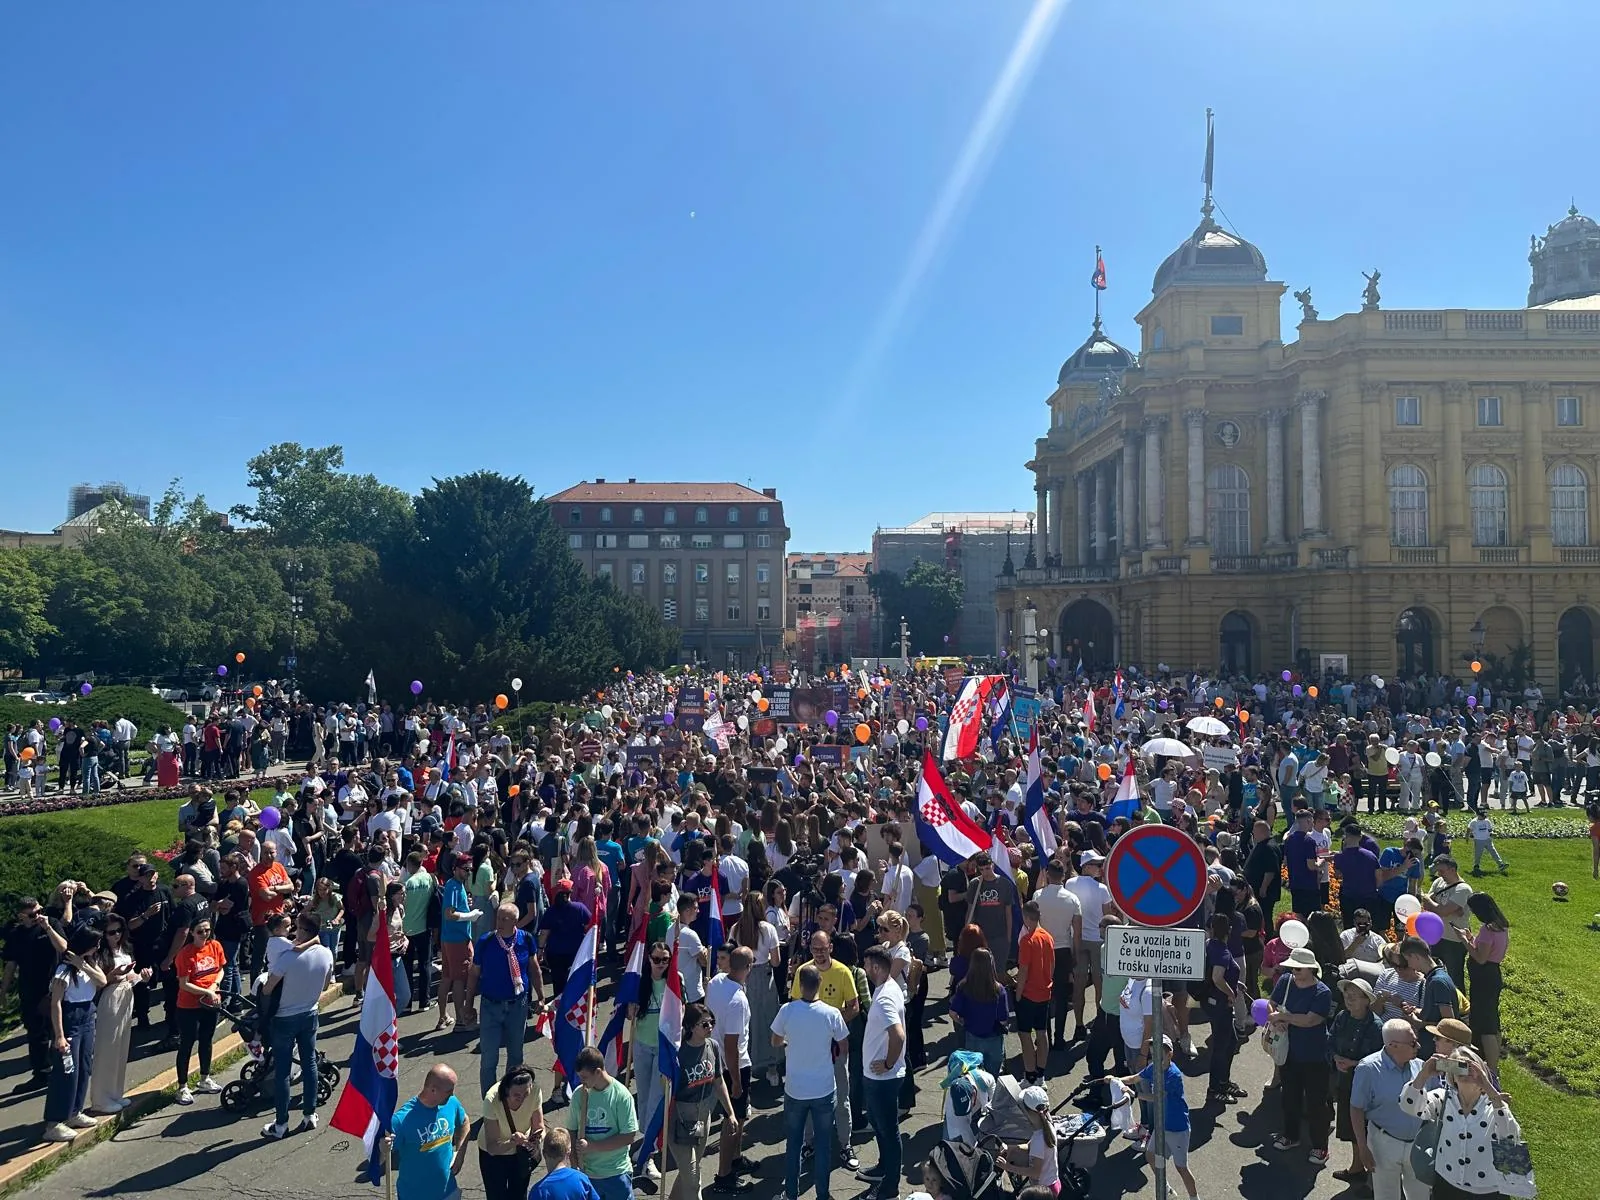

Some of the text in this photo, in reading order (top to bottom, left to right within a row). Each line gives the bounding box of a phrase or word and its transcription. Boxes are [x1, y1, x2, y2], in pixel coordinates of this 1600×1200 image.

[698, 885, 711, 896] HO
[1122, 932, 1190, 947] Sva vozila biti
[1120, 945, 1131, 956] će
[1135, 947, 1181, 961] uklonjena
[1118, 960, 1192, 975] trošku vlasnika
[685, 1060, 712, 1080] HOD
[587, 1107, 607, 1120] OD
[417, 1118, 449, 1140] HOD
